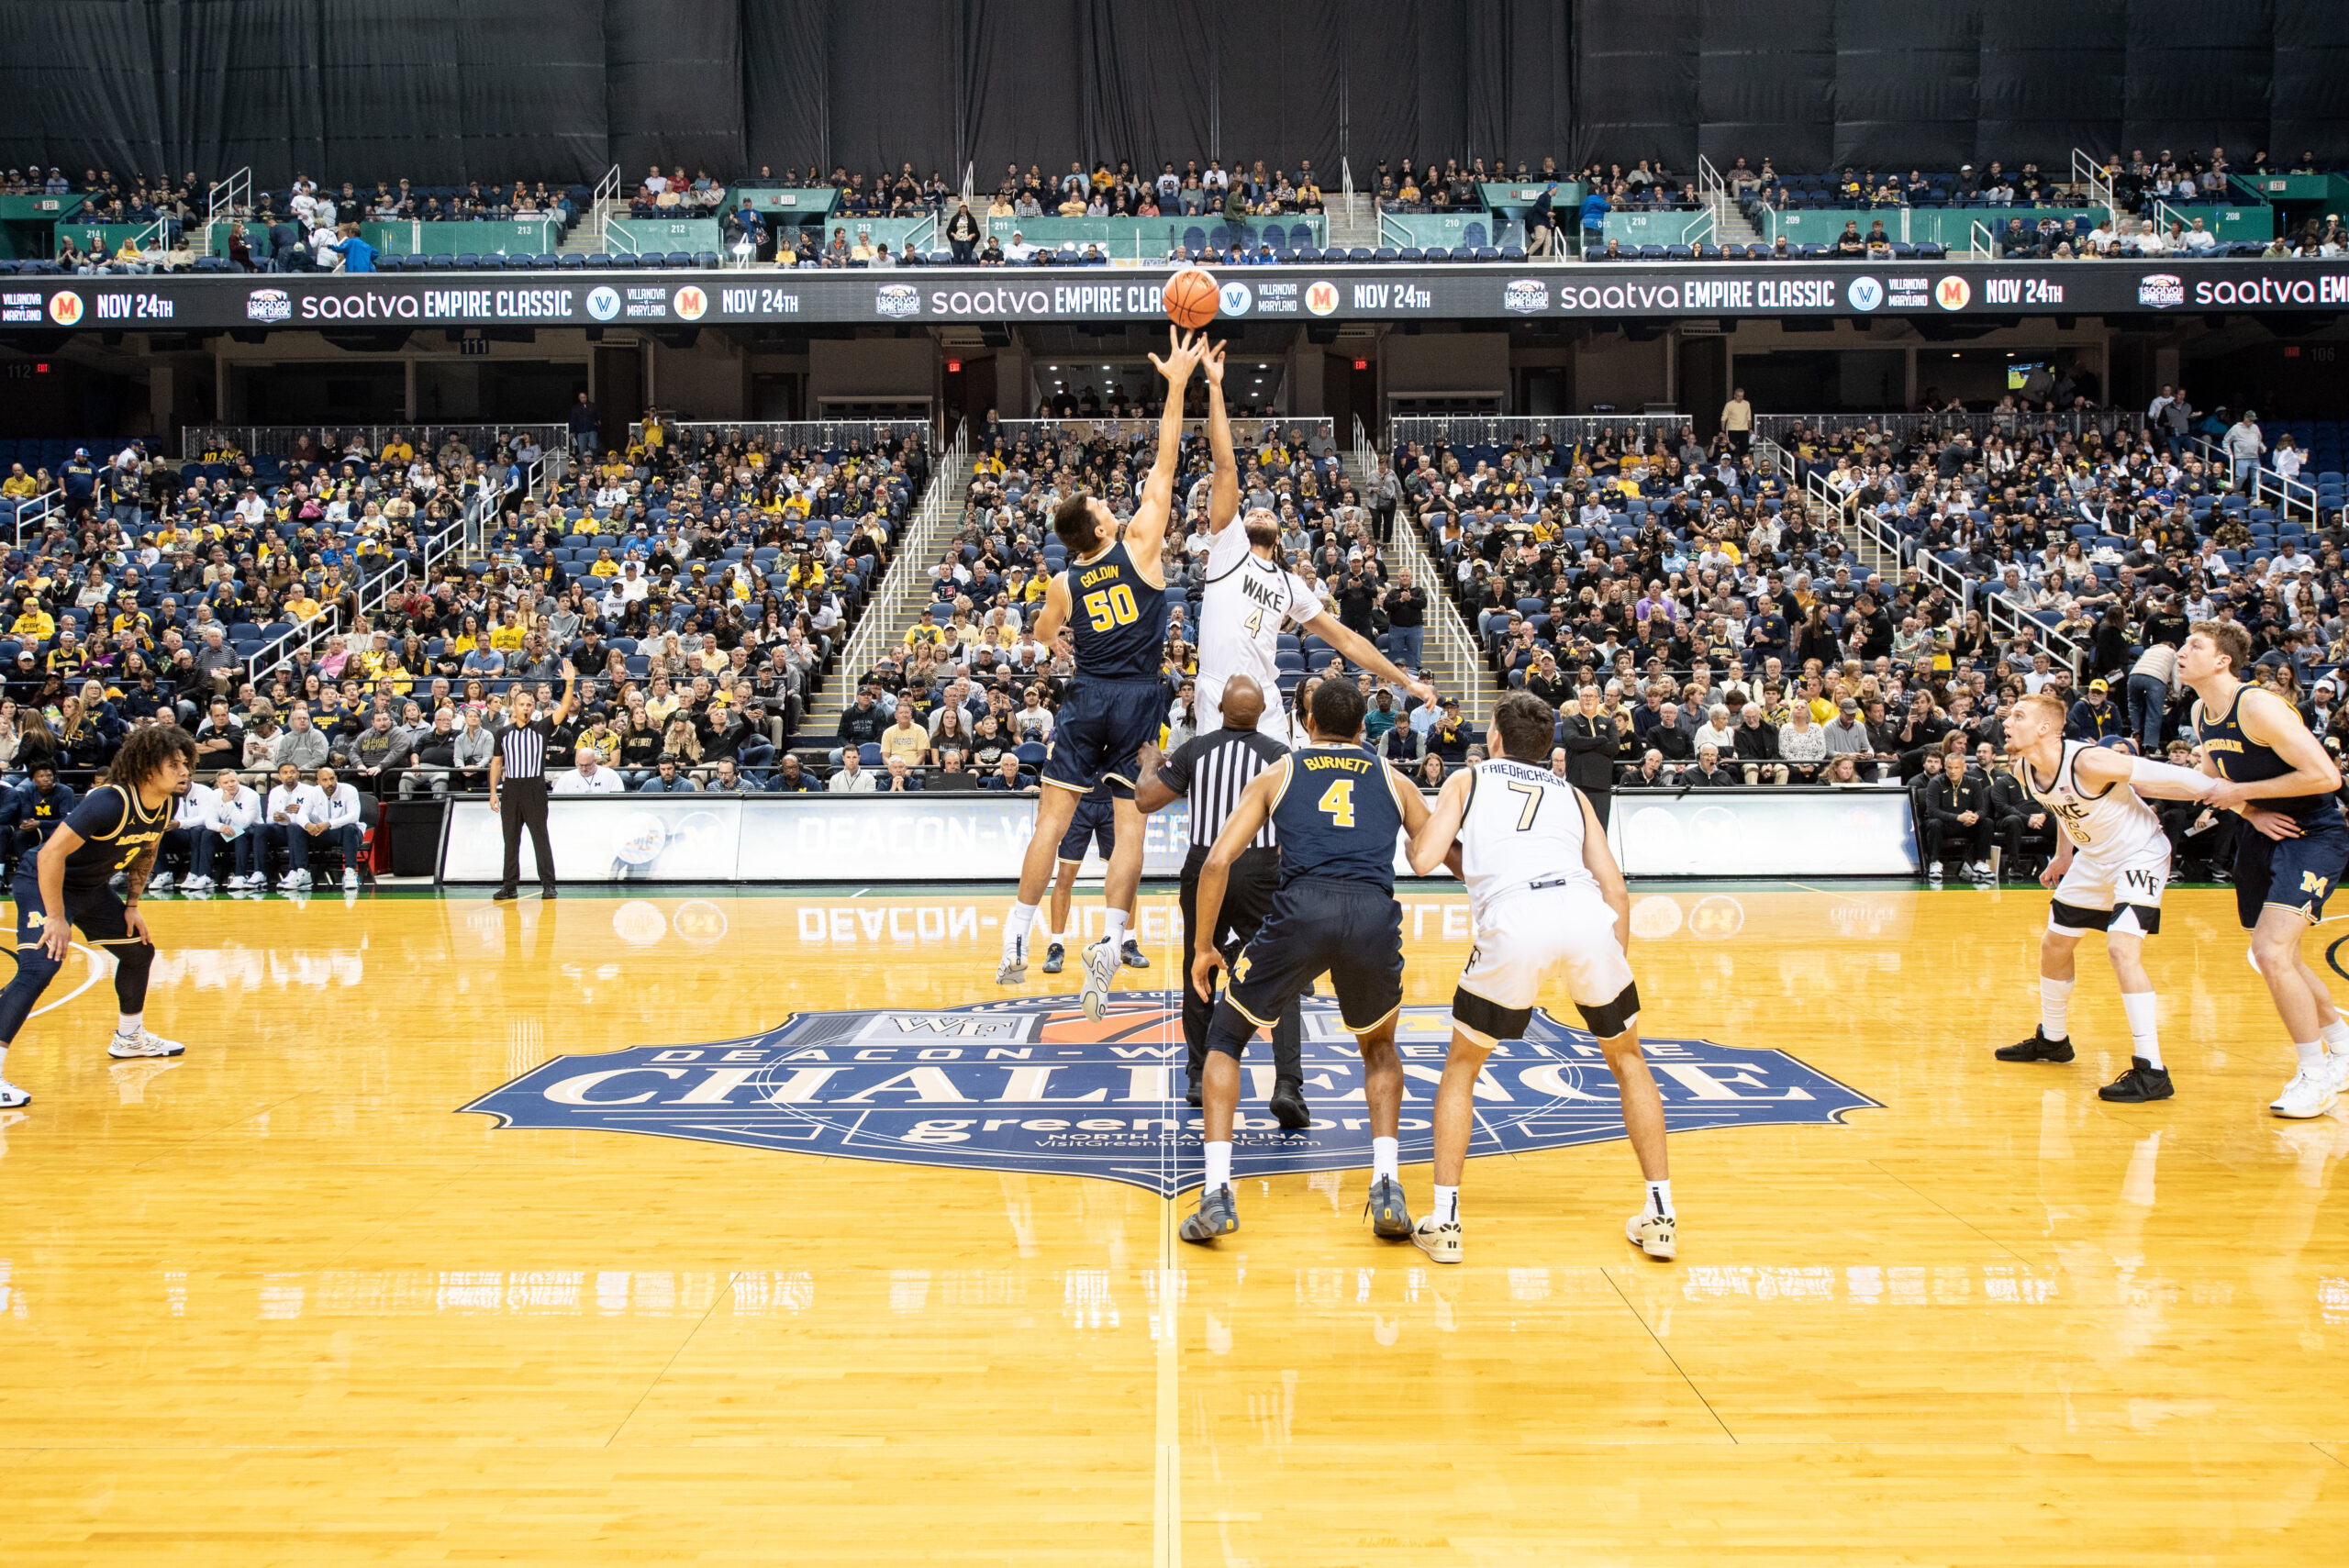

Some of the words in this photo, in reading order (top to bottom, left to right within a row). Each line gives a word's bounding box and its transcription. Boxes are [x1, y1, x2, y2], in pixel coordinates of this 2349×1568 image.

[2273, 182, 2285, 191] EXIT
[1522, 191, 1535, 200] EXIT
[45, 200, 57, 209] EXIT
[1631, 217, 1647, 226] 210
[1786, 216, 1799, 225] 209
[2226, 212, 2240, 220] 208
[671, 225, 685, 233] 212
[857, 223, 872, 232] 212
[995, 221, 1008, 230] 211
[1306, 219, 1319, 228] 211
[1445, 218, 1460, 228] 210
[86, 229, 100, 239] 214
[518, 226, 532, 235] 213
[1258, 284, 1297, 295] VILLANOVA
[1888, 278, 1928, 291] VILLANOVA
[627, 288, 666, 300] VILLANOVA
[1353, 284, 1389, 309] NOV
[1394, 284, 1431, 308] 24TH
[1561, 282, 1679, 309] saatva
[1685, 281, 1752, 309] EMPIRE
[1757, 280, 1835, 308] CLASSIC
[1986, 279, 2021, 304] NOV
[2025, 279, 2063, 304] 24TH
[2196, 277, 2315, 305] saatva
[3, 294, 42, 306] VILLANOVA
[97, 294, 132, 317] NOV
[137, 294, 174, 318] 24TH
[301, 292, 419, 318] saatva
[424, 290, 492, 317] EMPIRE
[496, 290, 573, 317] CLASSIC
[722, 289, 758, 314] NOV
[763, 289, 799, 313] 24TH
[931, 287, 1049, 315] saatva
[1055, 286, 1122, 313] EMPIRE
[1258, 300, 1297, 312] MARYLAND
[1888, 295, 1928, 306] MARYLAND
[3, 309, 42, 321] MARYLAND
[627, 305, 666, 317] MARYLAND
[462, 338, 487, 354] 111
[2310, 347, 2335, 361] 106
[37, 363, 49, 373] EXIT
[740, 492, 752, 503] M
[1080, 564, 1119, 588] GOLDIN
[1242, 574, 1285, 613] WAKE
[1083, 584, 1140, 633] 50
[1244, 607, 1264, 639] 4
[1709, 648, 1733, 656] MICHIGAN
[312, 716, 340, 724] MICHIGAN
[1303, 755, 1373, 775] BURNETT
[1481, 763, 1566, 789] FRIEDRICHSEN
[190, 798, 198, 806] M
[235, 801, 242, 809] M
[334, 800, 343, 808] M
[1319, 779, 1356, 828] 4
[1508, 781, 1544, 832] 7
[35, 806, 50, 816] M
[115, 846, 141, 870] 3
[2124, 870, 2160, 897] WF
[2299, 870, 2329, 898] M
